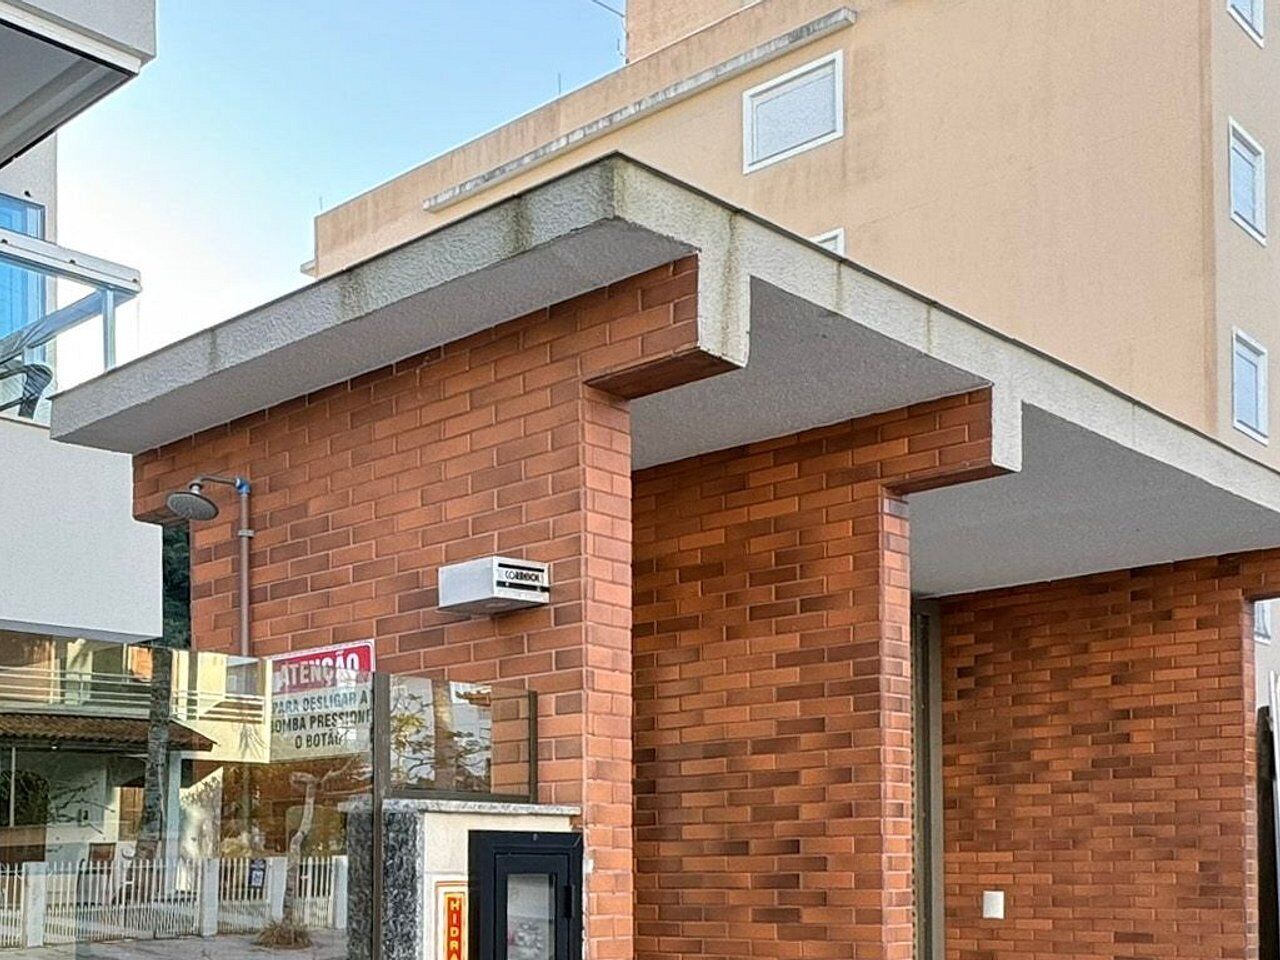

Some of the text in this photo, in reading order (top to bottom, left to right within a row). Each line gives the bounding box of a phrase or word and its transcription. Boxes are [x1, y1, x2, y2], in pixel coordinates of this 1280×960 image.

[279, 650, 359, 685] ATENÇÃO
[272, 690, 368, 714] PARA DESLIGAR A
[295, 735, 302, 749] O
